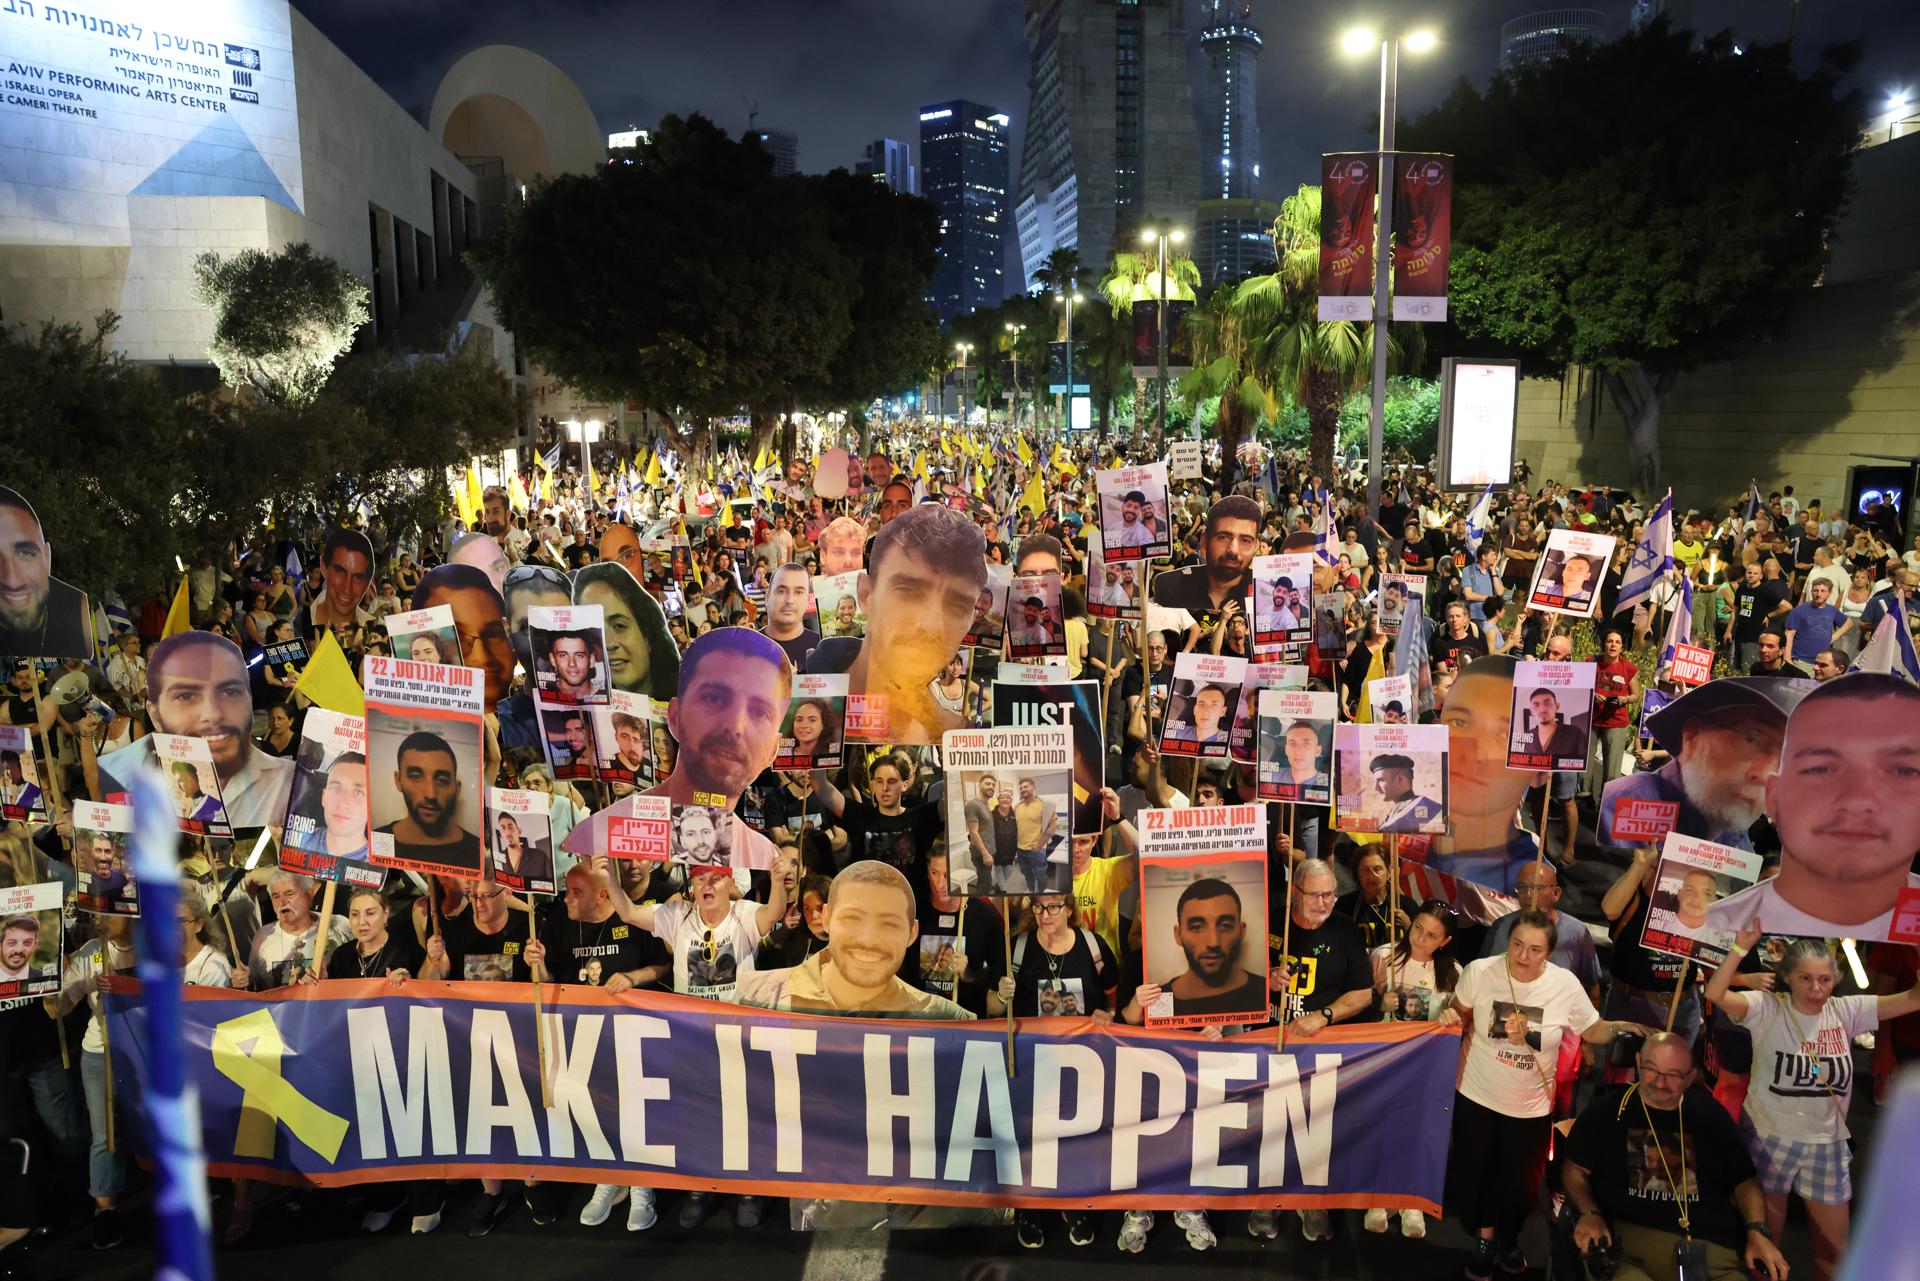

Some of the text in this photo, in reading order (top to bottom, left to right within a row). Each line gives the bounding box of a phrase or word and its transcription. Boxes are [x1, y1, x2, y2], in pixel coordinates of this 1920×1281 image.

[45, 6, 219, 58] המשכן לאמנויות
[110, 47, 220, 79] האופרה הישראלית
[8, 62, 227, 113] AVIV PERFORMING ARTS CENTER
[115, 66, 222, 96] התיאטרון הקאמרי
[5, 80, 83, 102] ISRAELI OPERA
[7, 95, 98, 119] CAMERI THEATRE
[1383, 571, 1424, 583] KIDNAPPED
[266, 642, 300, 656] END THE WAR
[371, 657, 388, 676] 22
[375, 677, 389, 686] קשה
[448, 667, 472, 687] מתן
[442, 686, 459, 696] לשמור
[460, 688, 471, 697] יצא
[402, 693, 479, 710] והוצא המדינה מהרשימה
[1166, 719, 1186, 731] BRING
[334, 726, 353, 738] MATAN
[1164, 729, 1177, 739] HIM
[1232, 728, 1252, 738] BRING
[1512, 733, 1534, 744] BRING
[778, 738, 796, 748] RING
[949, 733, 1065, 749] גלי וזיו ברמן (27), חטופים.
[1161, 739, 1179, 751] HOME
[1180, 741, 1200, 752] NOW!
[1232, 738, 1245, 747] HIM
[1511, 743, 1525, 753] HIM
[949, 750, 1066, 767] תמונת הניצחון המוחלט
[1510, 753, 1531, 765] HOME
[1531, 754, 1553, 766] NOW!
[1260, 760, 1280, 773] BRING
[1260, 772, 1272, 784] HIM
[1259, 784, 1279, 796] HOME
[1337, 795, 1358, 806] BRING
[1634, 803, 1674, 817] עדיין
[1146, 811, 1165, 830] 22
[1230, 807, 1256, 827] מתן
[286, 813, 316, 835] BRING
[626, 821, 665, 836] עדיין
[1621, 820, 1670, 834] בעזה.
[1151, 831, 1167, 840] קשה
[1168, 830, 1184, 840] נפצע
[1223, 827, 1243, 837] לשמור
[1243, 827, 1255, 836] יצא
[283, 830, 303, 848] HIM
[1181, 839, 1264, 851] והוצא המדינה מהרשימה
[617, 839, 665, 854] בעזה.
[281, 847, 307, 867] HOME
[8, 897, 21, 905] DAVID
[1078, 896, 1097, 907] DEAL
[1650, 906, 1676, 923] BRING
[1647, 917, 1665, 932] HIM
[1645, 930, 1667, 945] HOME
[572, 944, 619, 958] רום ברסלבסקי
[1204, 1016, 1225, 1024] להחזיר
[1801, 1042, 1828, 1055] הביתה
[1773, 1050, 1852, 1091] עכשיו
[349, 1005, 1342, 1191] MAKE IT HAPPEN
